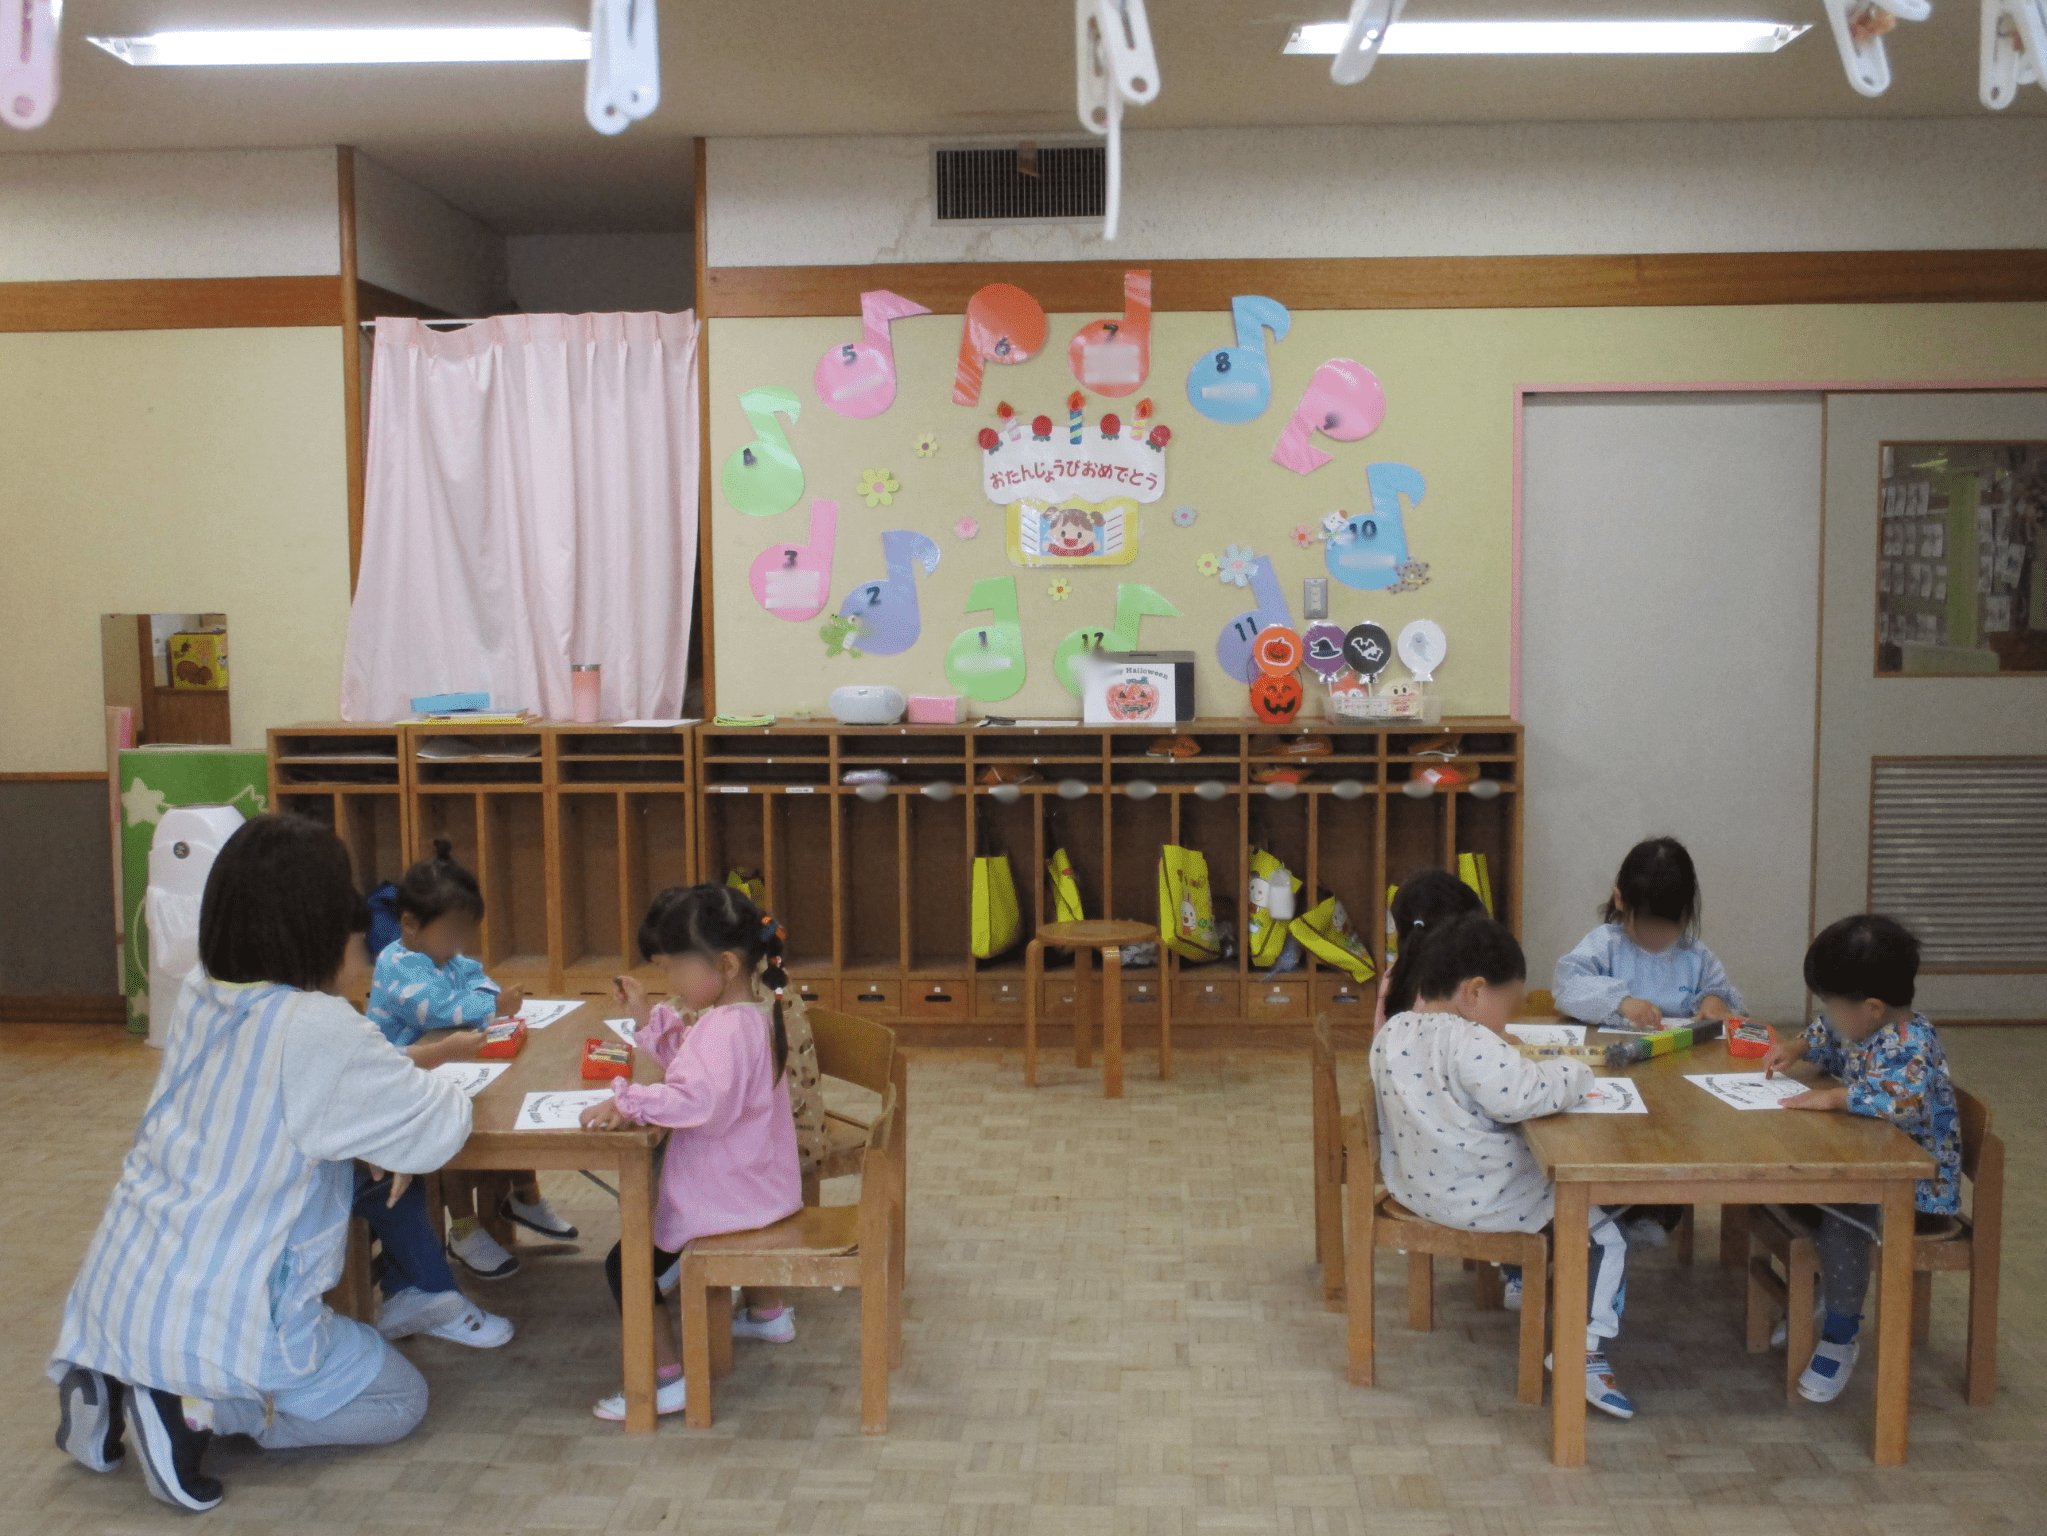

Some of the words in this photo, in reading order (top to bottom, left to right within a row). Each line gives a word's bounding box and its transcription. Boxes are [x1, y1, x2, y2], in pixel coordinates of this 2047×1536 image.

[1103, 323, 1119, 343] 7
[842, 343, 857, 365] 5
[995, 336, 1011, 356] 6
[1215, 351, 1231, 373] 8
[990, 459, 1158, 491] おたんじょうびおめでとう
[866, 586, 882, 606] 2
[1235, 616, 1258, 641] 11
[1125, 667, 1169, 680] Halloween
